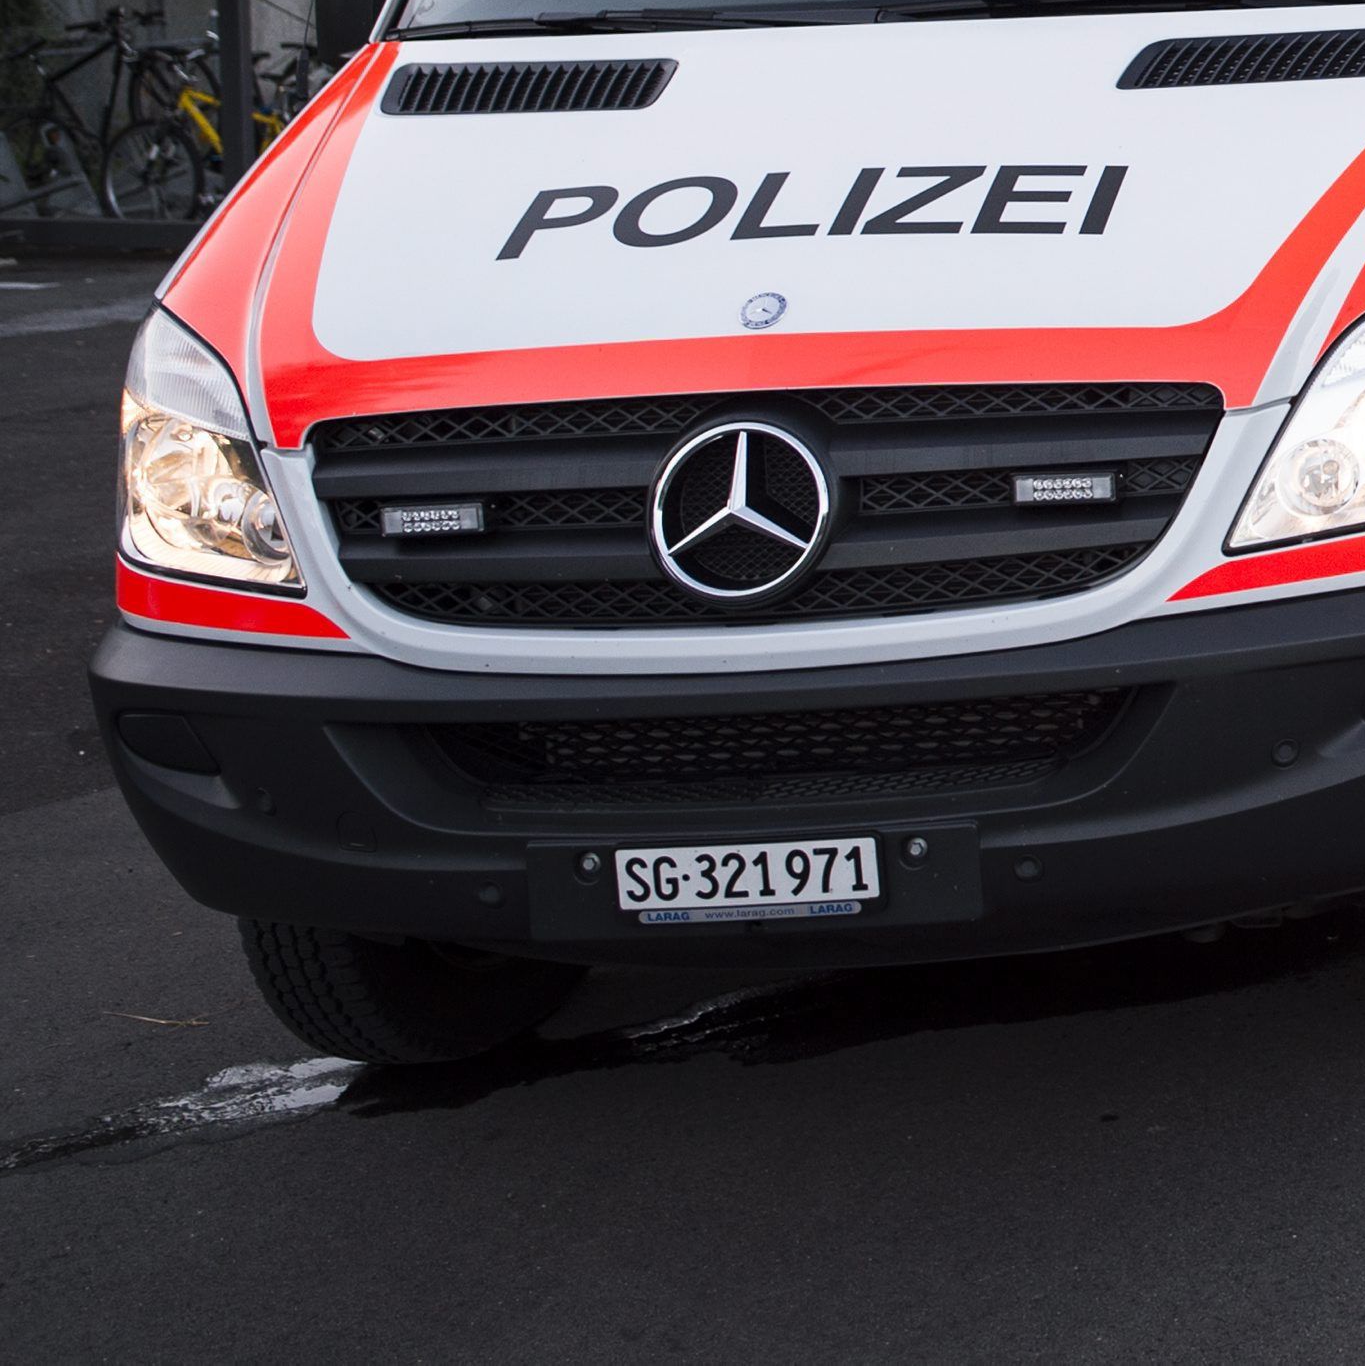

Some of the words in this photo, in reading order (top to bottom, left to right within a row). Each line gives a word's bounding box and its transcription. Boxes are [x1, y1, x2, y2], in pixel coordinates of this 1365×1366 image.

[495, 165, 1129, 261] POLIZEI
[647, 911, 690, 922] LARAG
[705, 906, 795, 919] www.larag.com
[809, 903, 853, 915] LARAG
